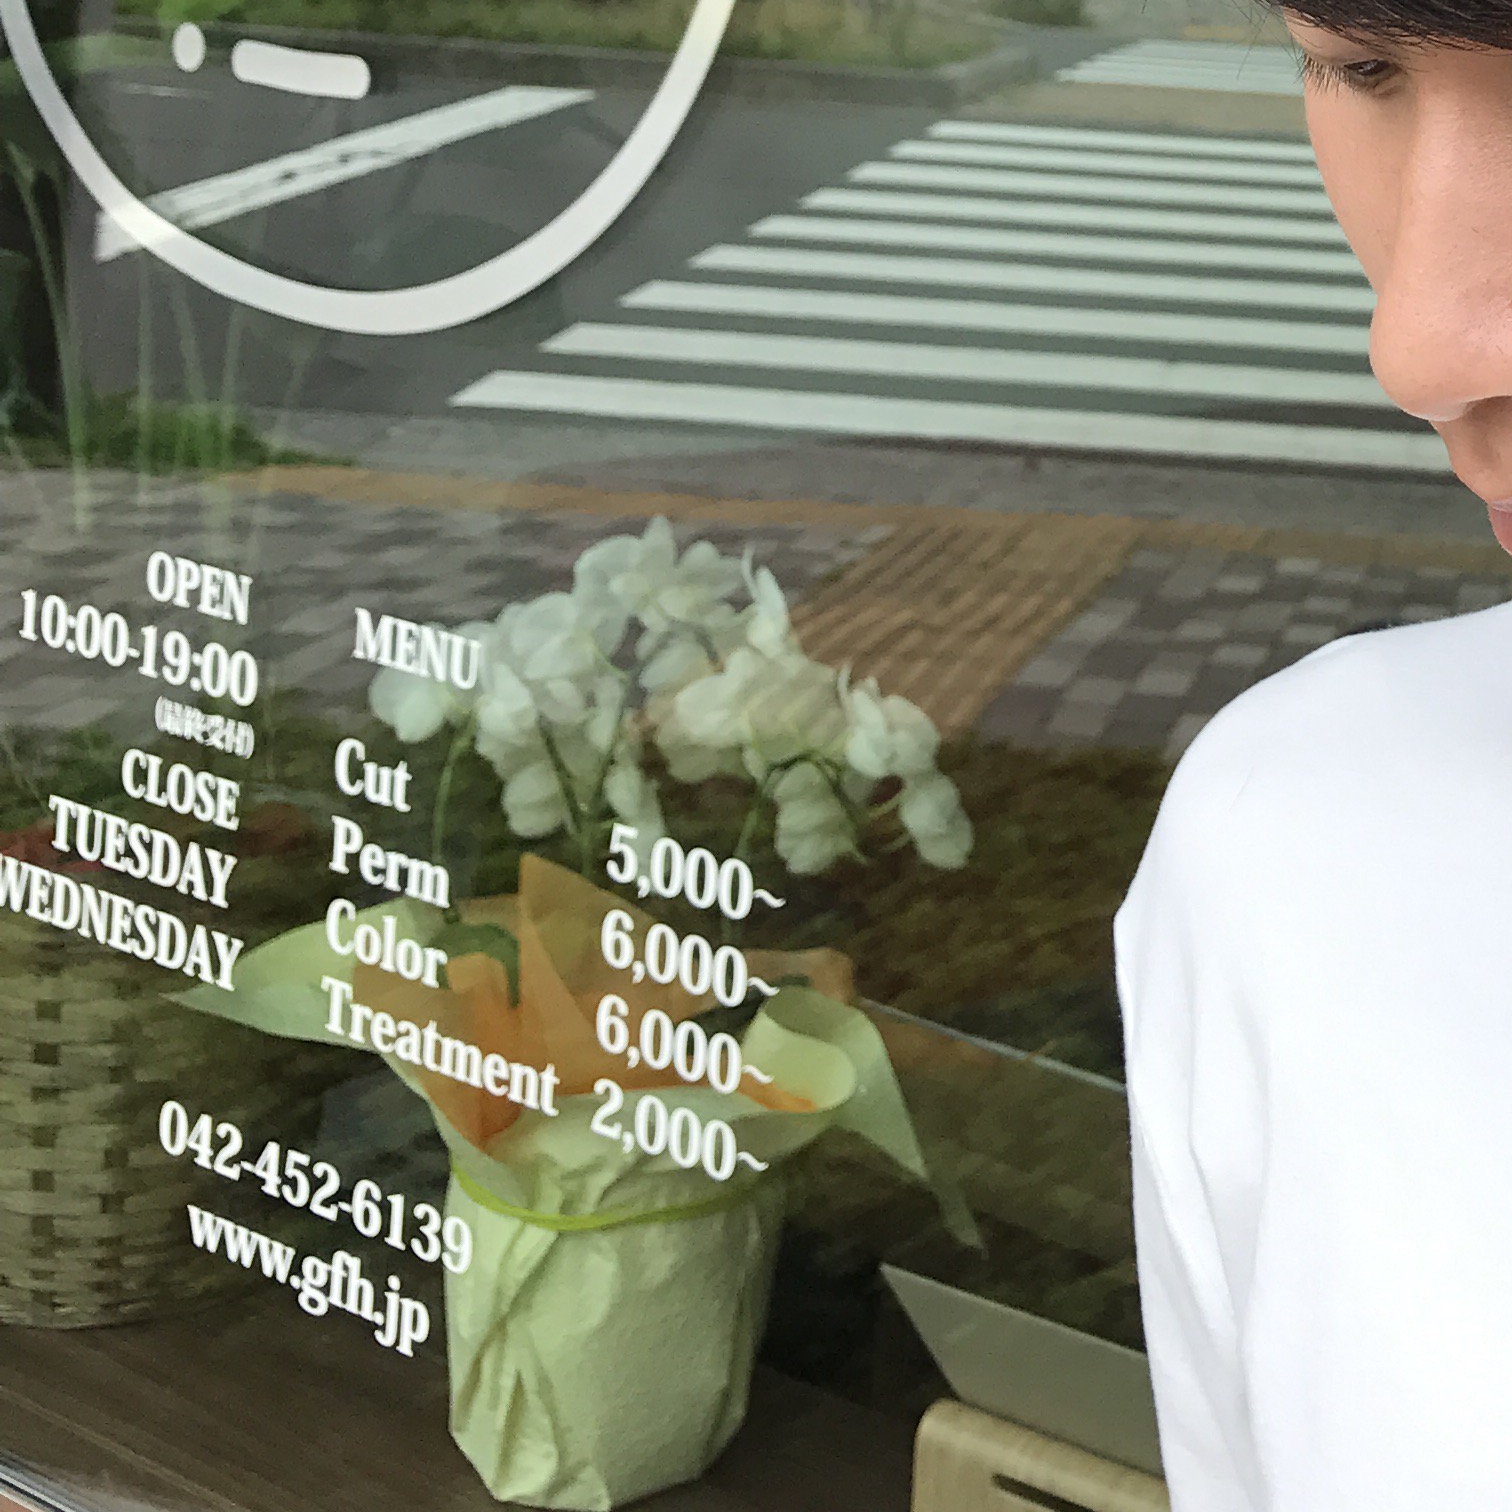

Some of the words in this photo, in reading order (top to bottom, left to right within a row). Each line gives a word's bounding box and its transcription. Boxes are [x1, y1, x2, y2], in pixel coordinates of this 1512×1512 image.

[146, 550, 253, 625] OPEN
[18, 588, 258, 707] 10:00-19:00
[352, 607, 480, 690] MENU
[121, 748, 241, 831] CLOSE
[334, 737, 412, 813] Cut
[48, 794, 238, 909] TUESDAY
[328, 815, 450, 909] Perm
[0, 852, 244, 991] WEDNESDAY
[325, 898, 448, 989] Color
[320, 975, 560, 1117] Treatment
[158, 1100, 473, 1274] 042-452-6139
[187, 1204, 430, 1357] www.gfh.jp
